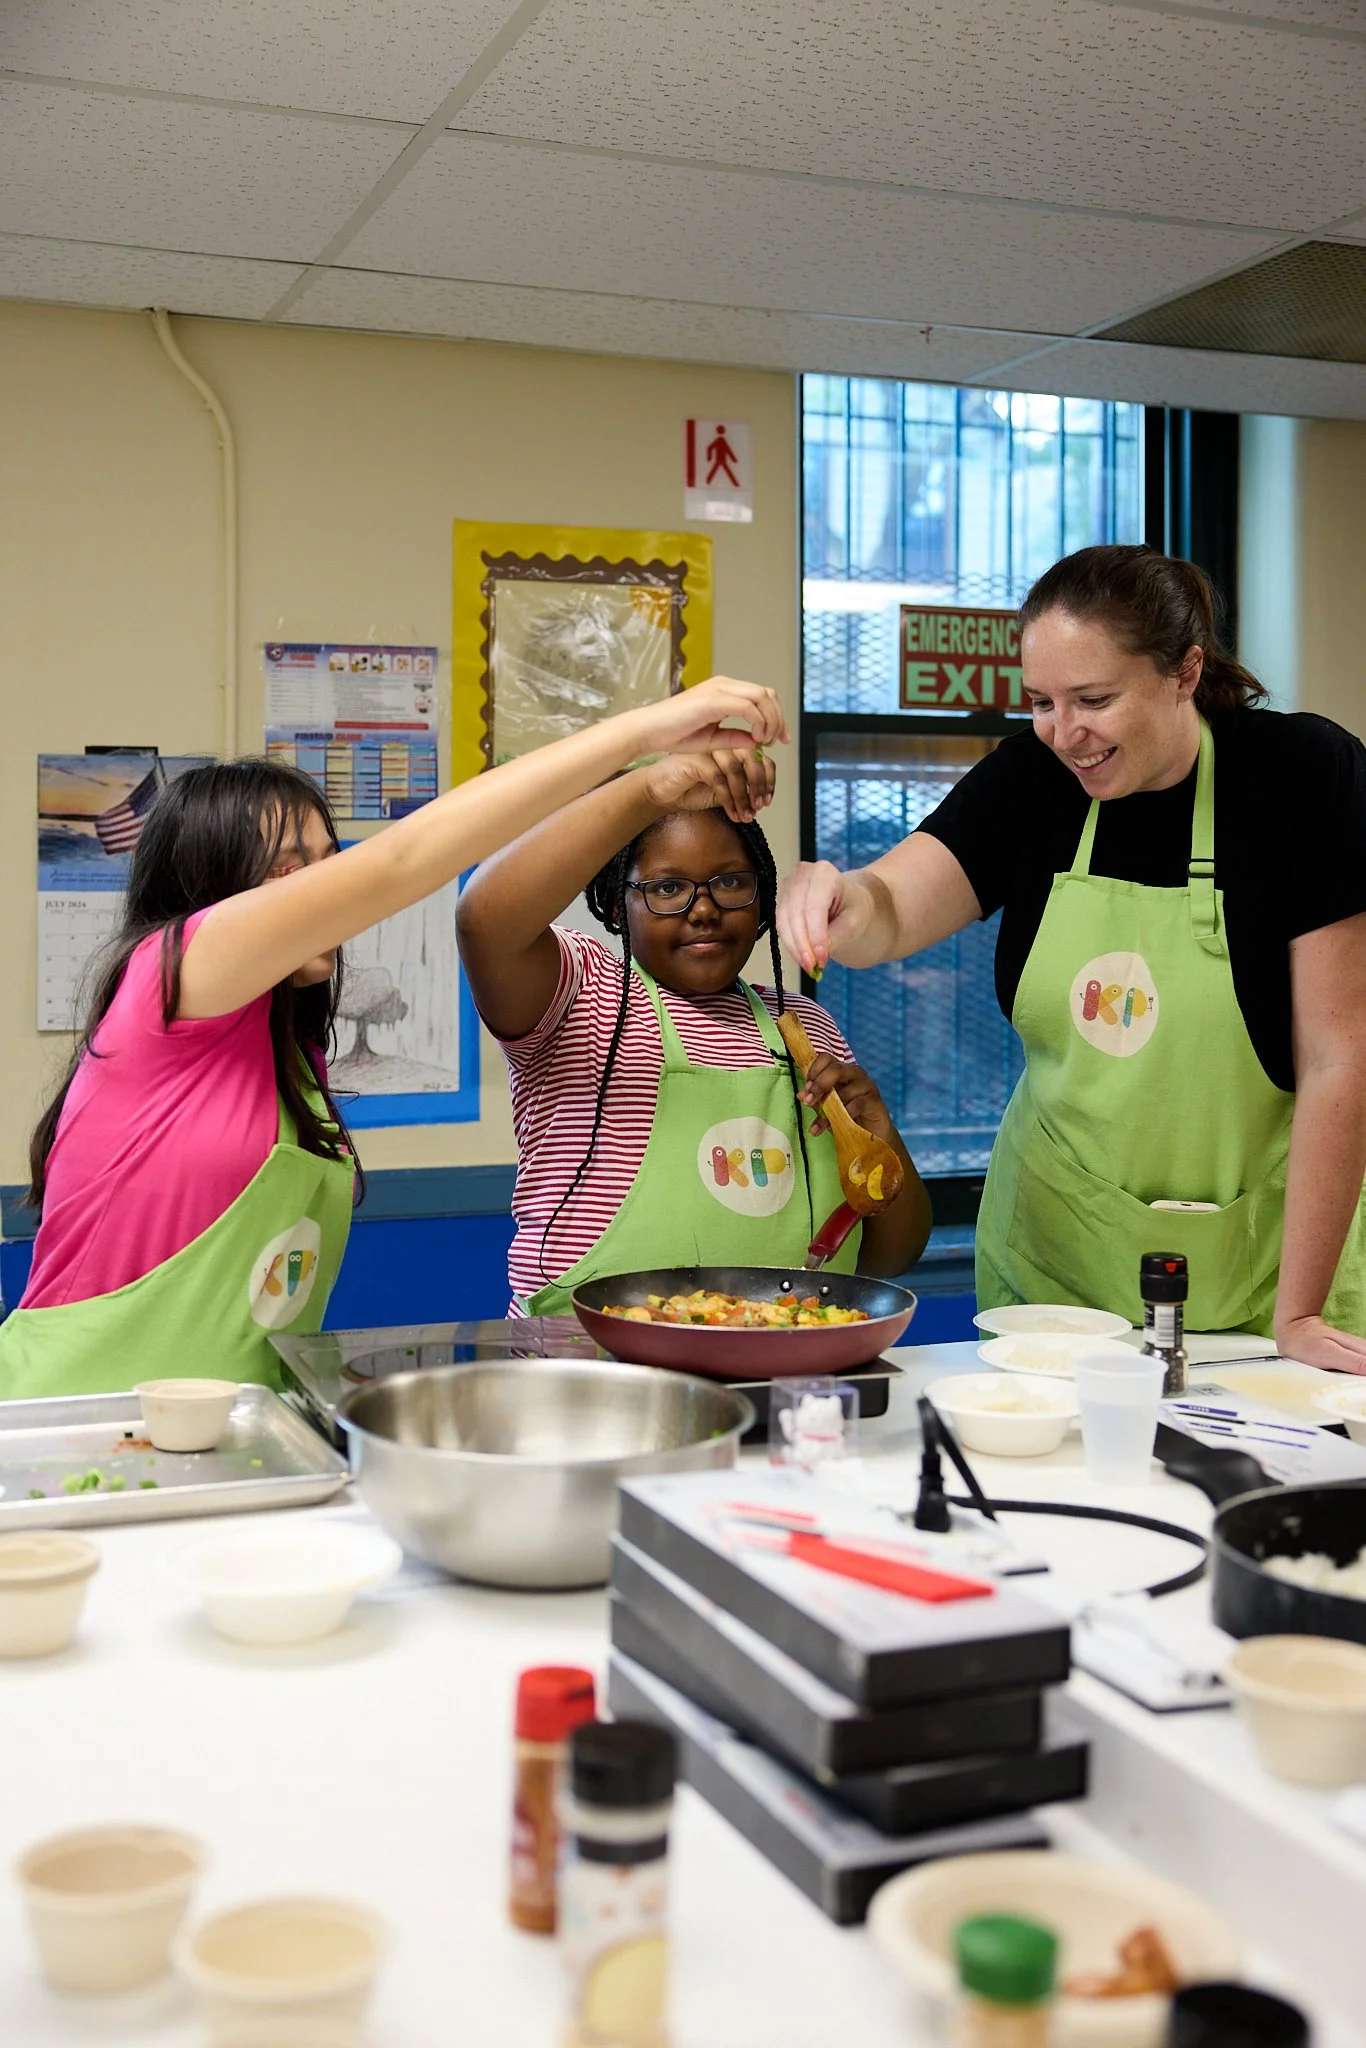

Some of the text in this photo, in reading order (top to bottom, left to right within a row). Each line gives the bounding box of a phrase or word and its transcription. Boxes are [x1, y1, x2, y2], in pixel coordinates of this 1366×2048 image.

[907, 613, 1018, 657] EMERGENC
[906, 662, 1022, 706] EXIT
[45, 901, 65, 909] JULY
